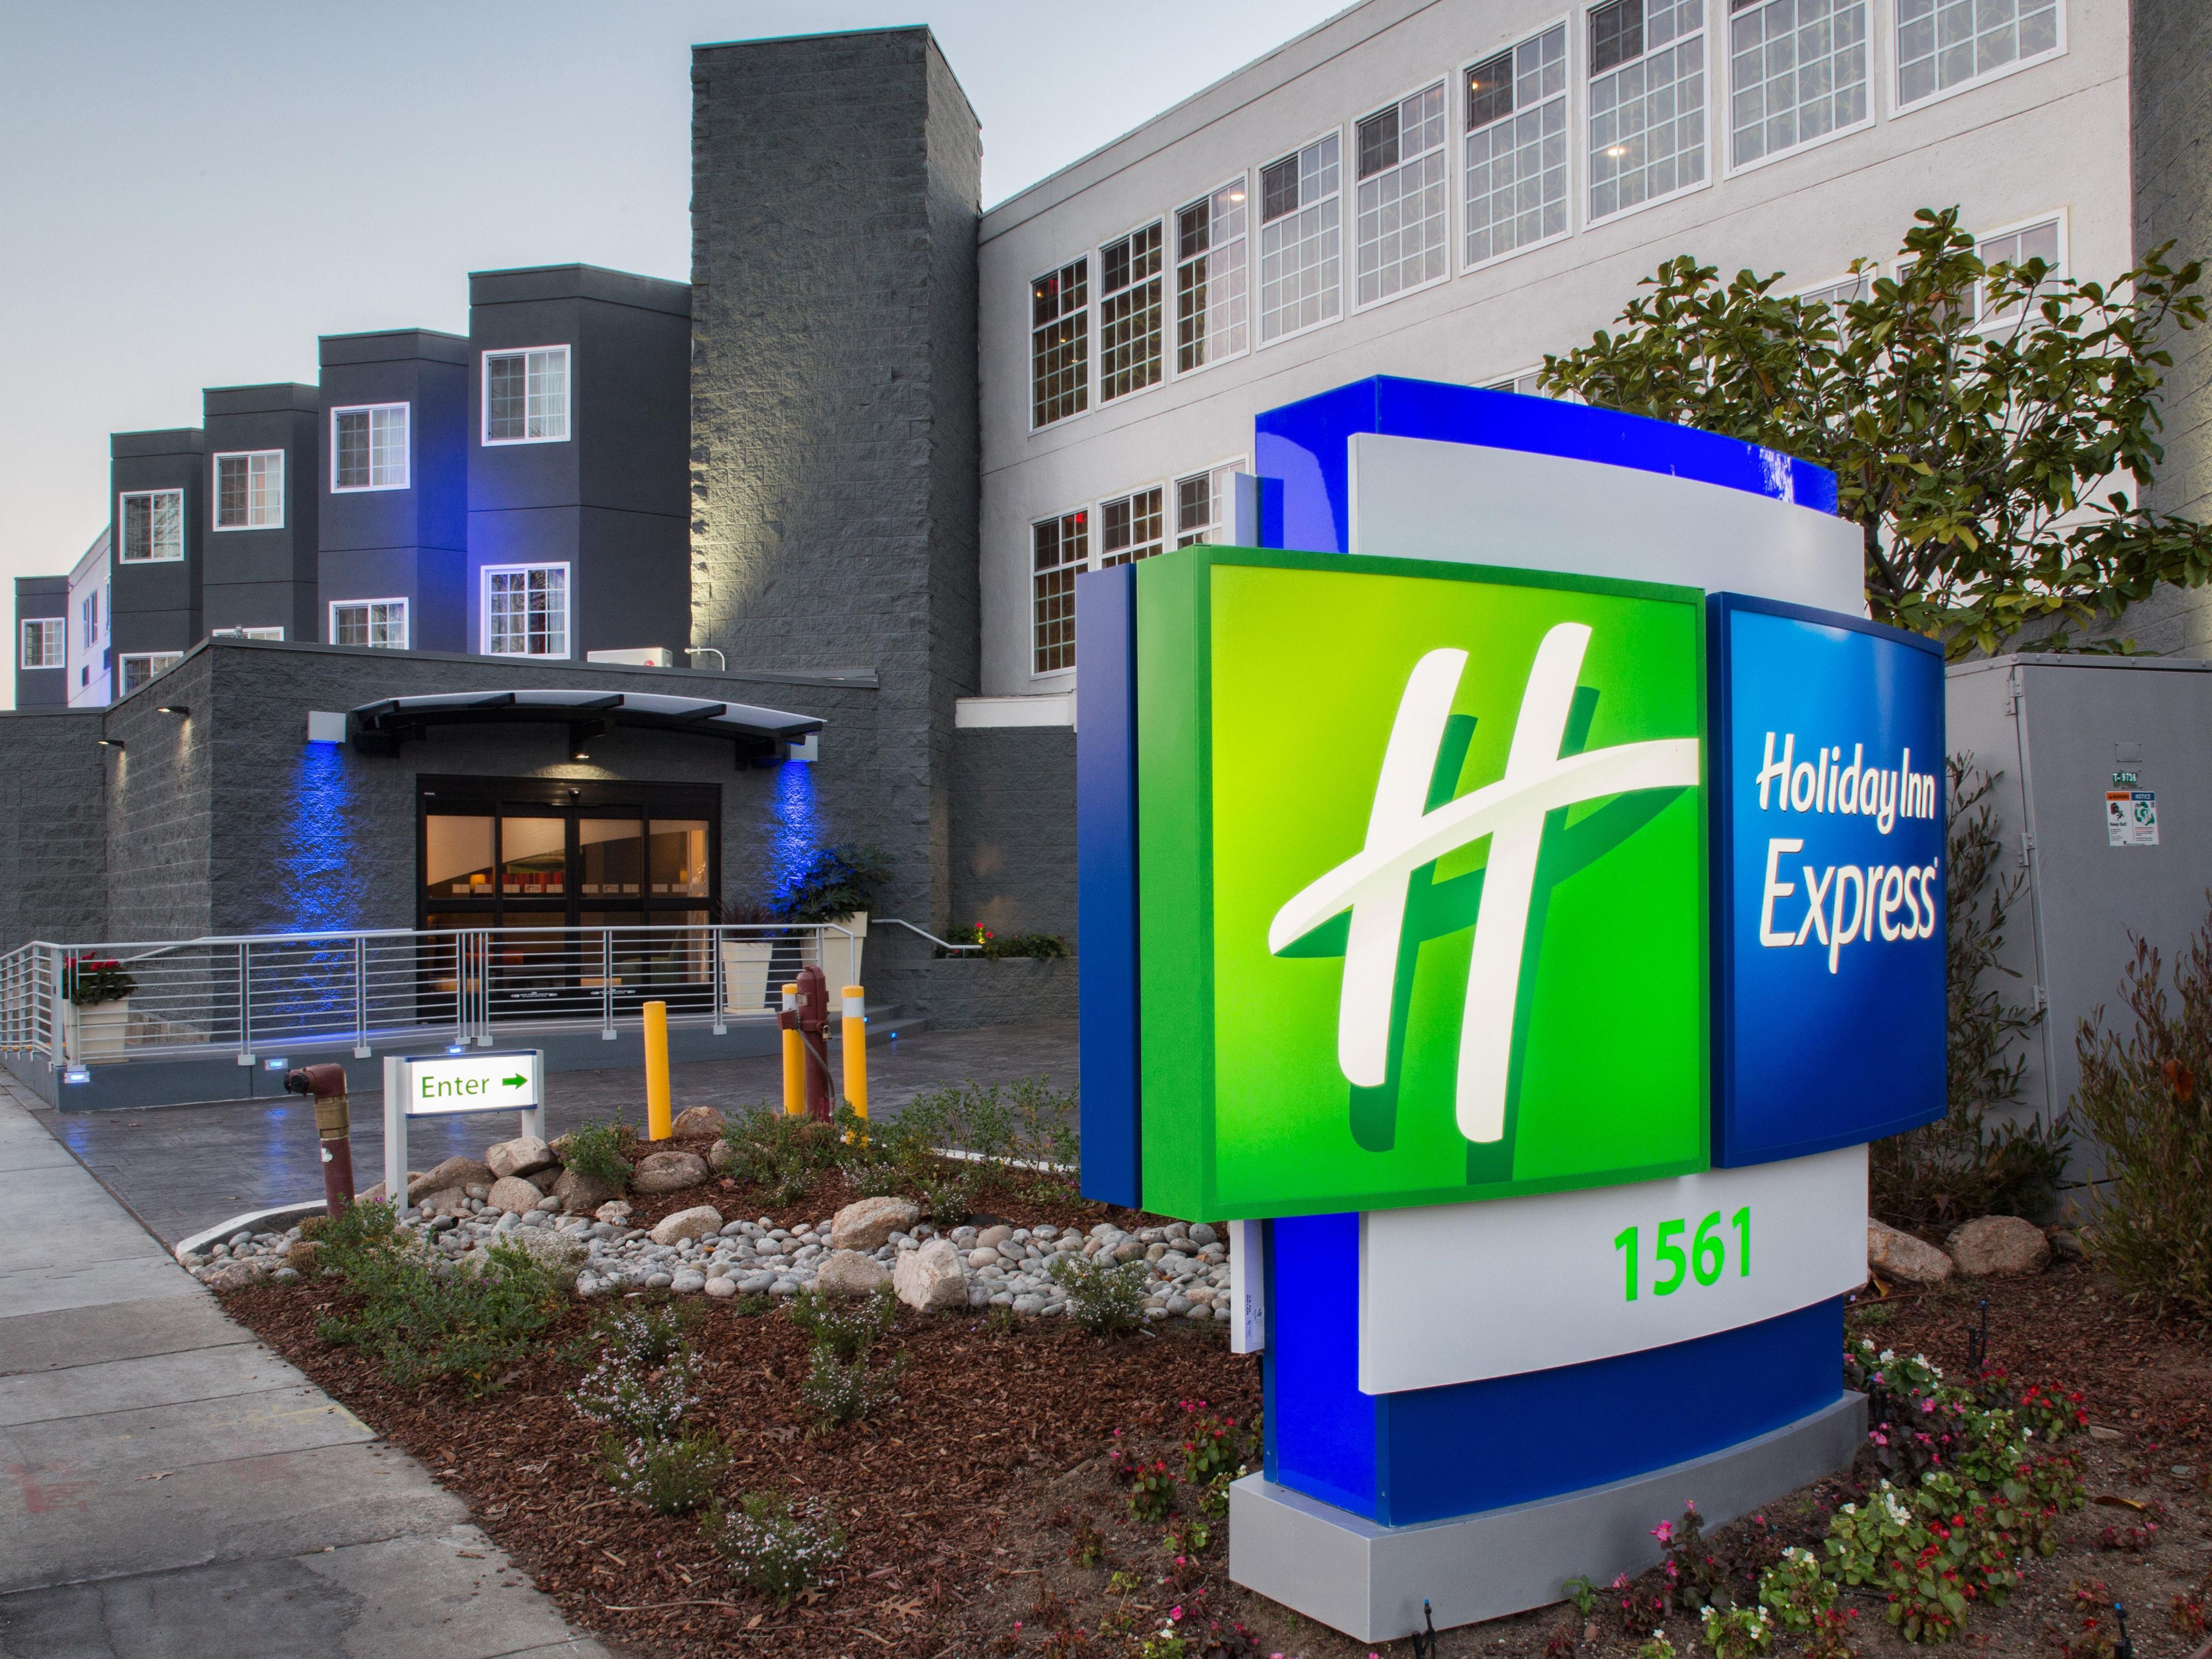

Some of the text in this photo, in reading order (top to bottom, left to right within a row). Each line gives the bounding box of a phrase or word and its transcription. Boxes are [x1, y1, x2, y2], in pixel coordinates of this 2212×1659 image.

[1756, 731, 1935, 835] Holiday Inn
[1268, 622, 1700, 1143] H
[1760, 838, 1936, 974] Express
[422, 1076, 490, 1098] Enter
[1614, 1206, 1750, 1302] 1561
